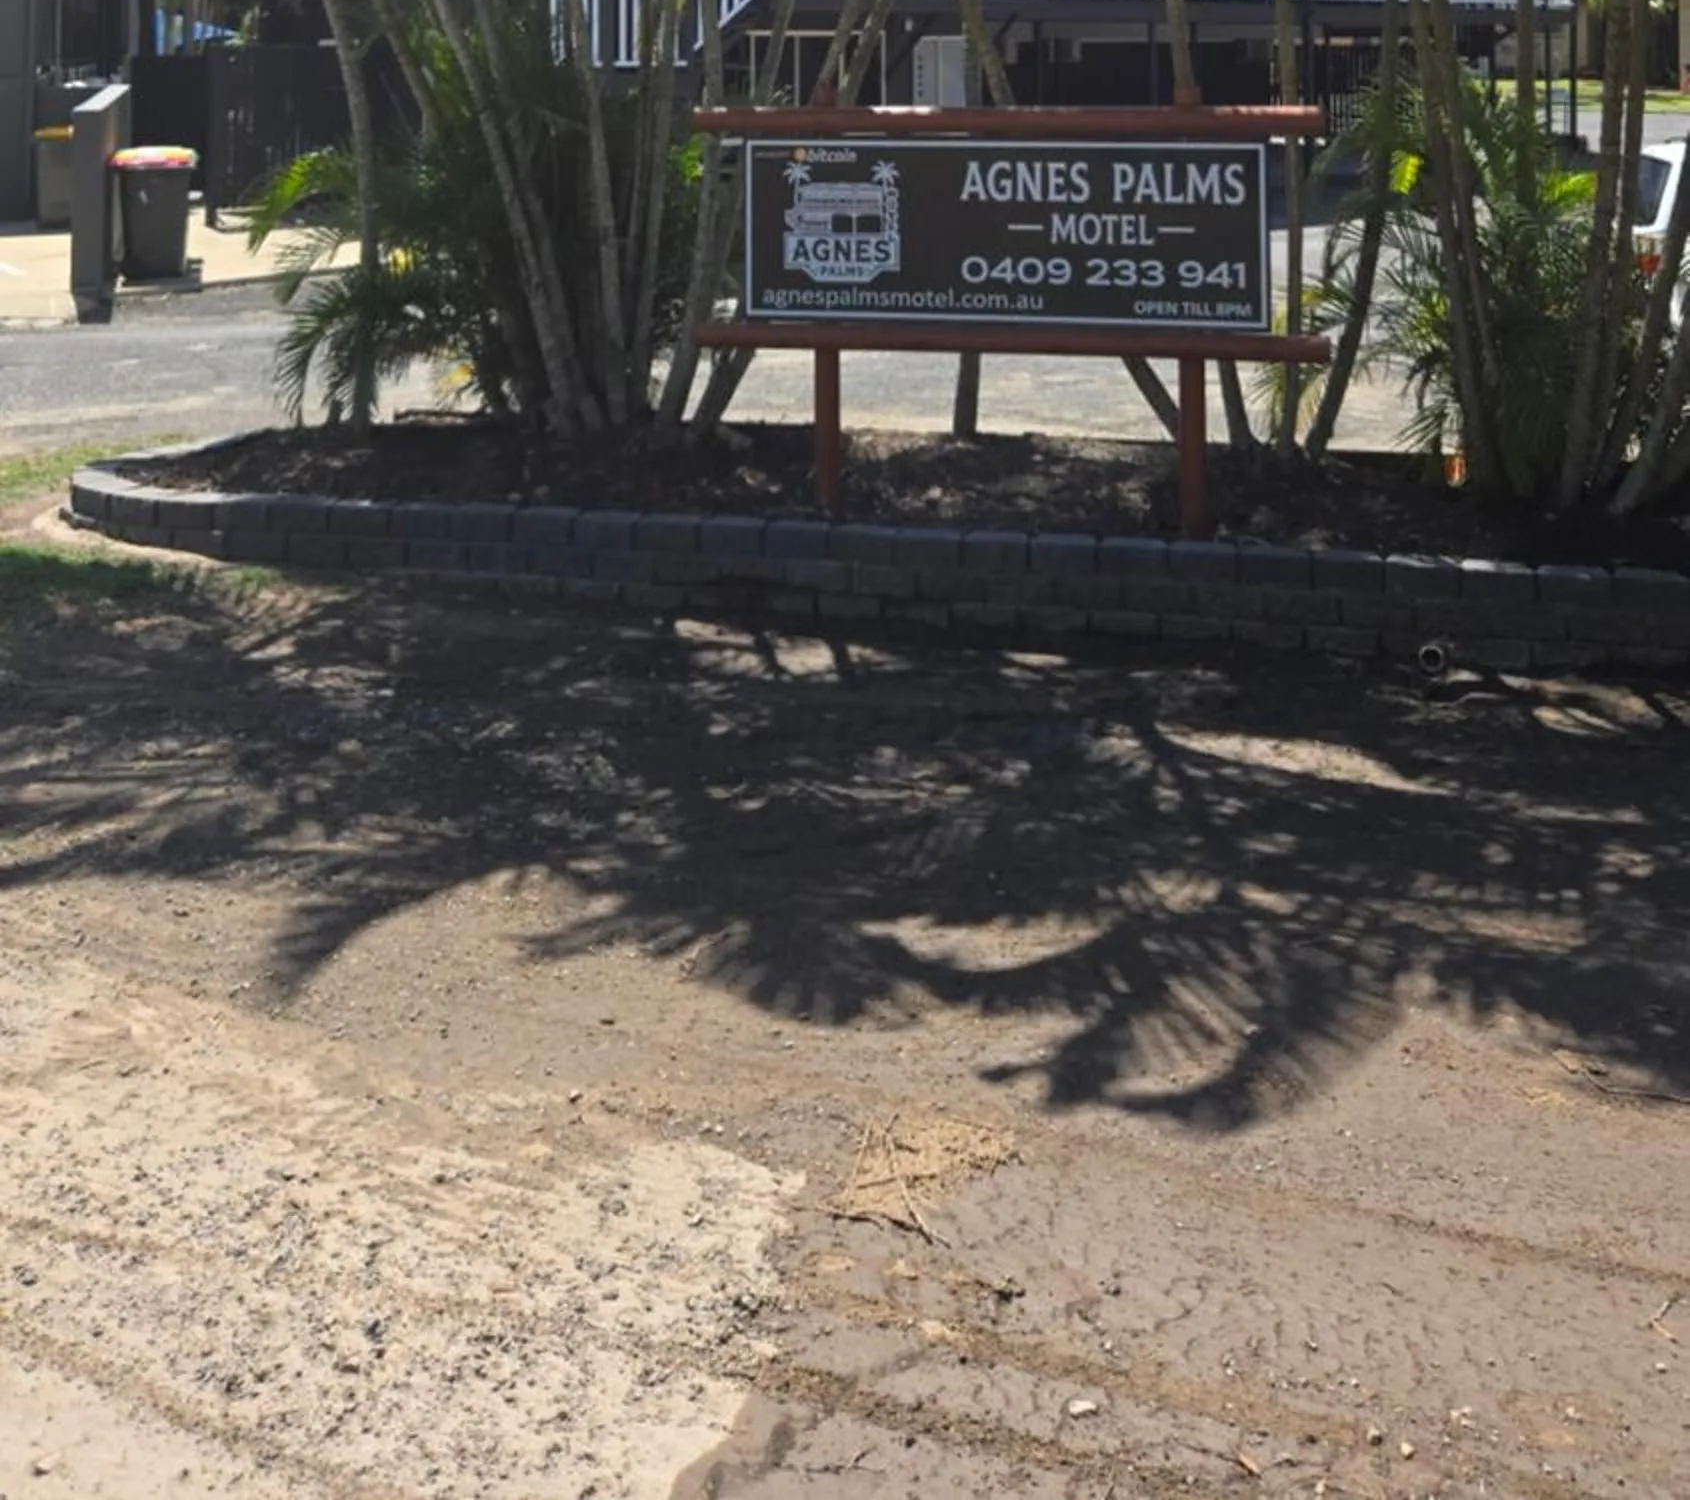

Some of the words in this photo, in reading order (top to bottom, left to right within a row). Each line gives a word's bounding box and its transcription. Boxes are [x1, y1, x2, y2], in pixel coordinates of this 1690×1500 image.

[807, 148, 857, 163] bitcoin
[960, 161, 1090, 203] AGNES
[1112, 163, 1246, 206] PALMS
[1050, 213, 1154, 245] MOTEL
[792, 239, 891, 263] AGNES
[820, 265, 864, 277] PALMS
[961, 256, 1071, 285] 0409
[1085, 258, 1165, 287] 233
[1179, 261, 1246, 290] 941
[762, 286, 1044, 312] agnespalmsmotel.com.au
[1133, 300, 1178, 317] OPEN
[1183, 301, 1213, 317] TILL
